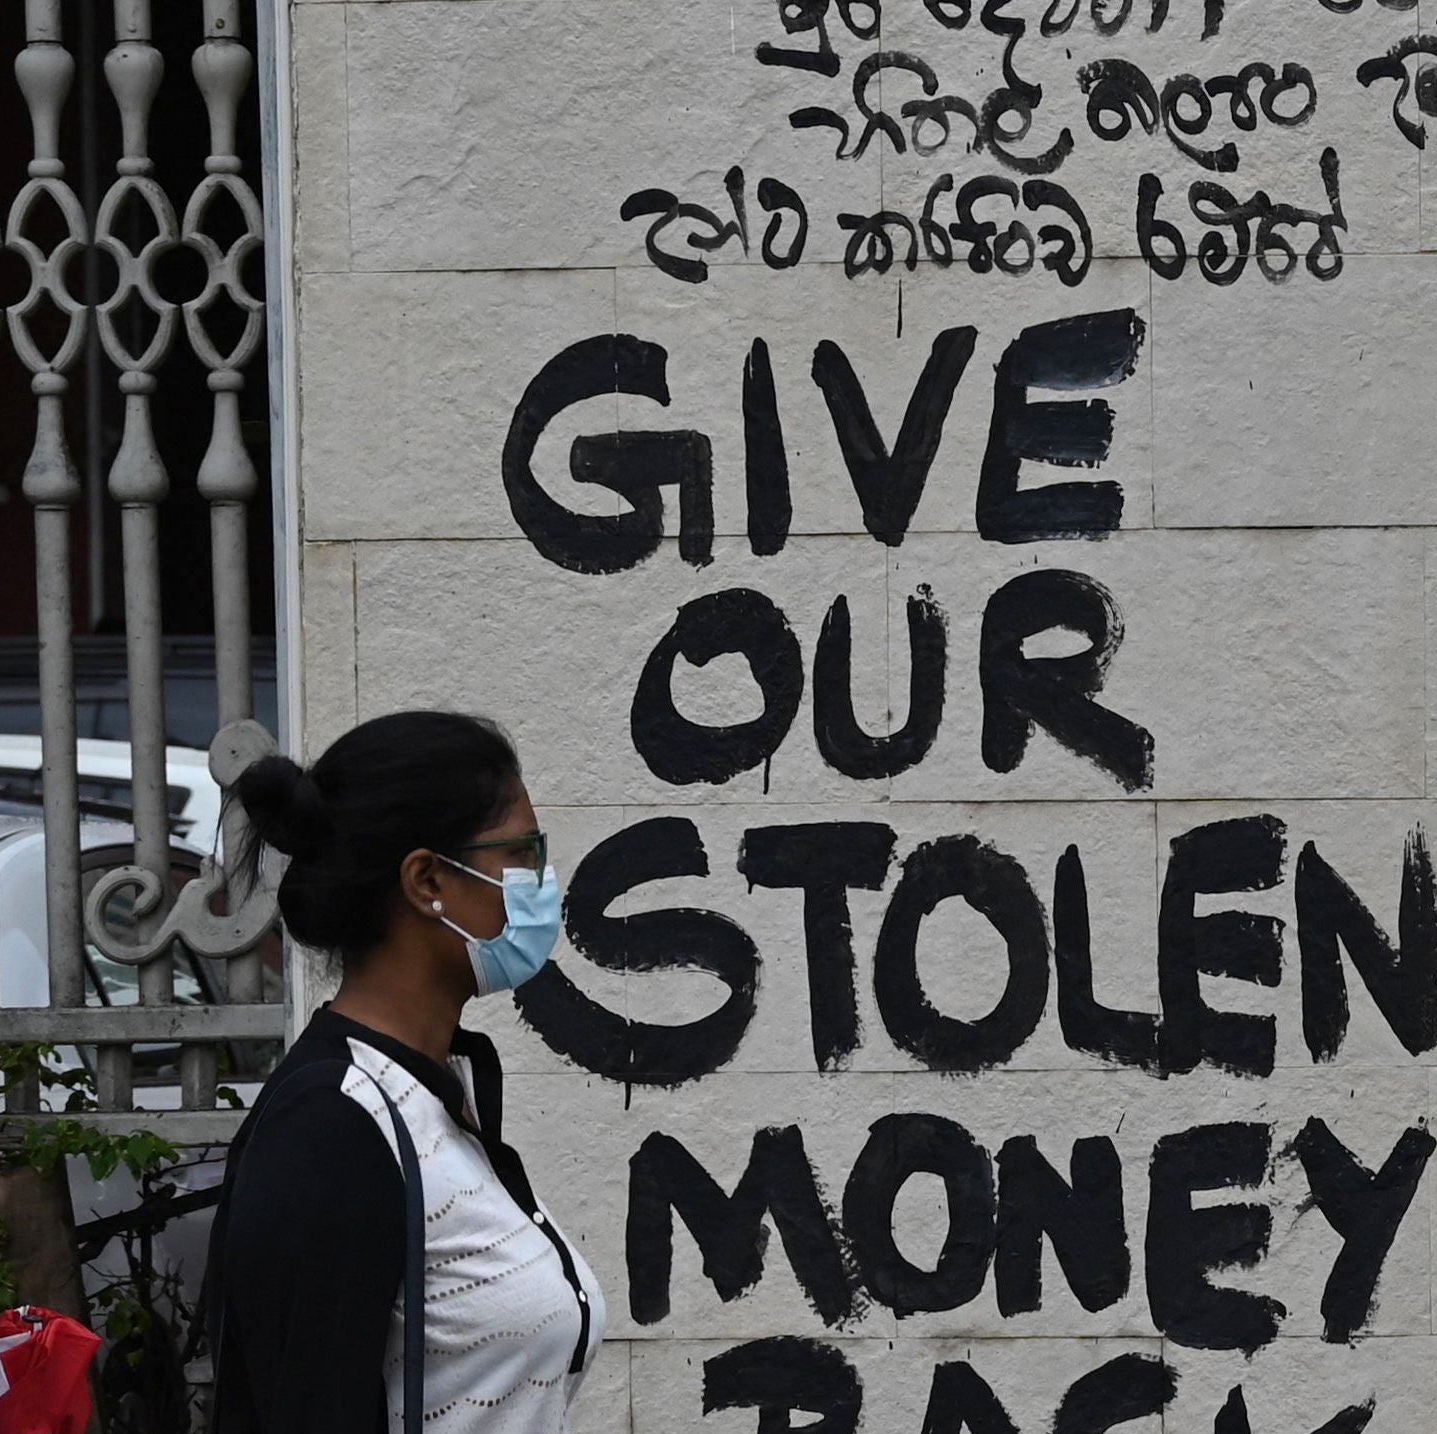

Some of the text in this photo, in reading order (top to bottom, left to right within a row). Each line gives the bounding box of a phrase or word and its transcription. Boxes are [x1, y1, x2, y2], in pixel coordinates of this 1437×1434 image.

[502, 308, 1146, 575] GIVE
[630, 569, 1154, 794] OUR
[626, 1113, 1437, 1356] MONEY
